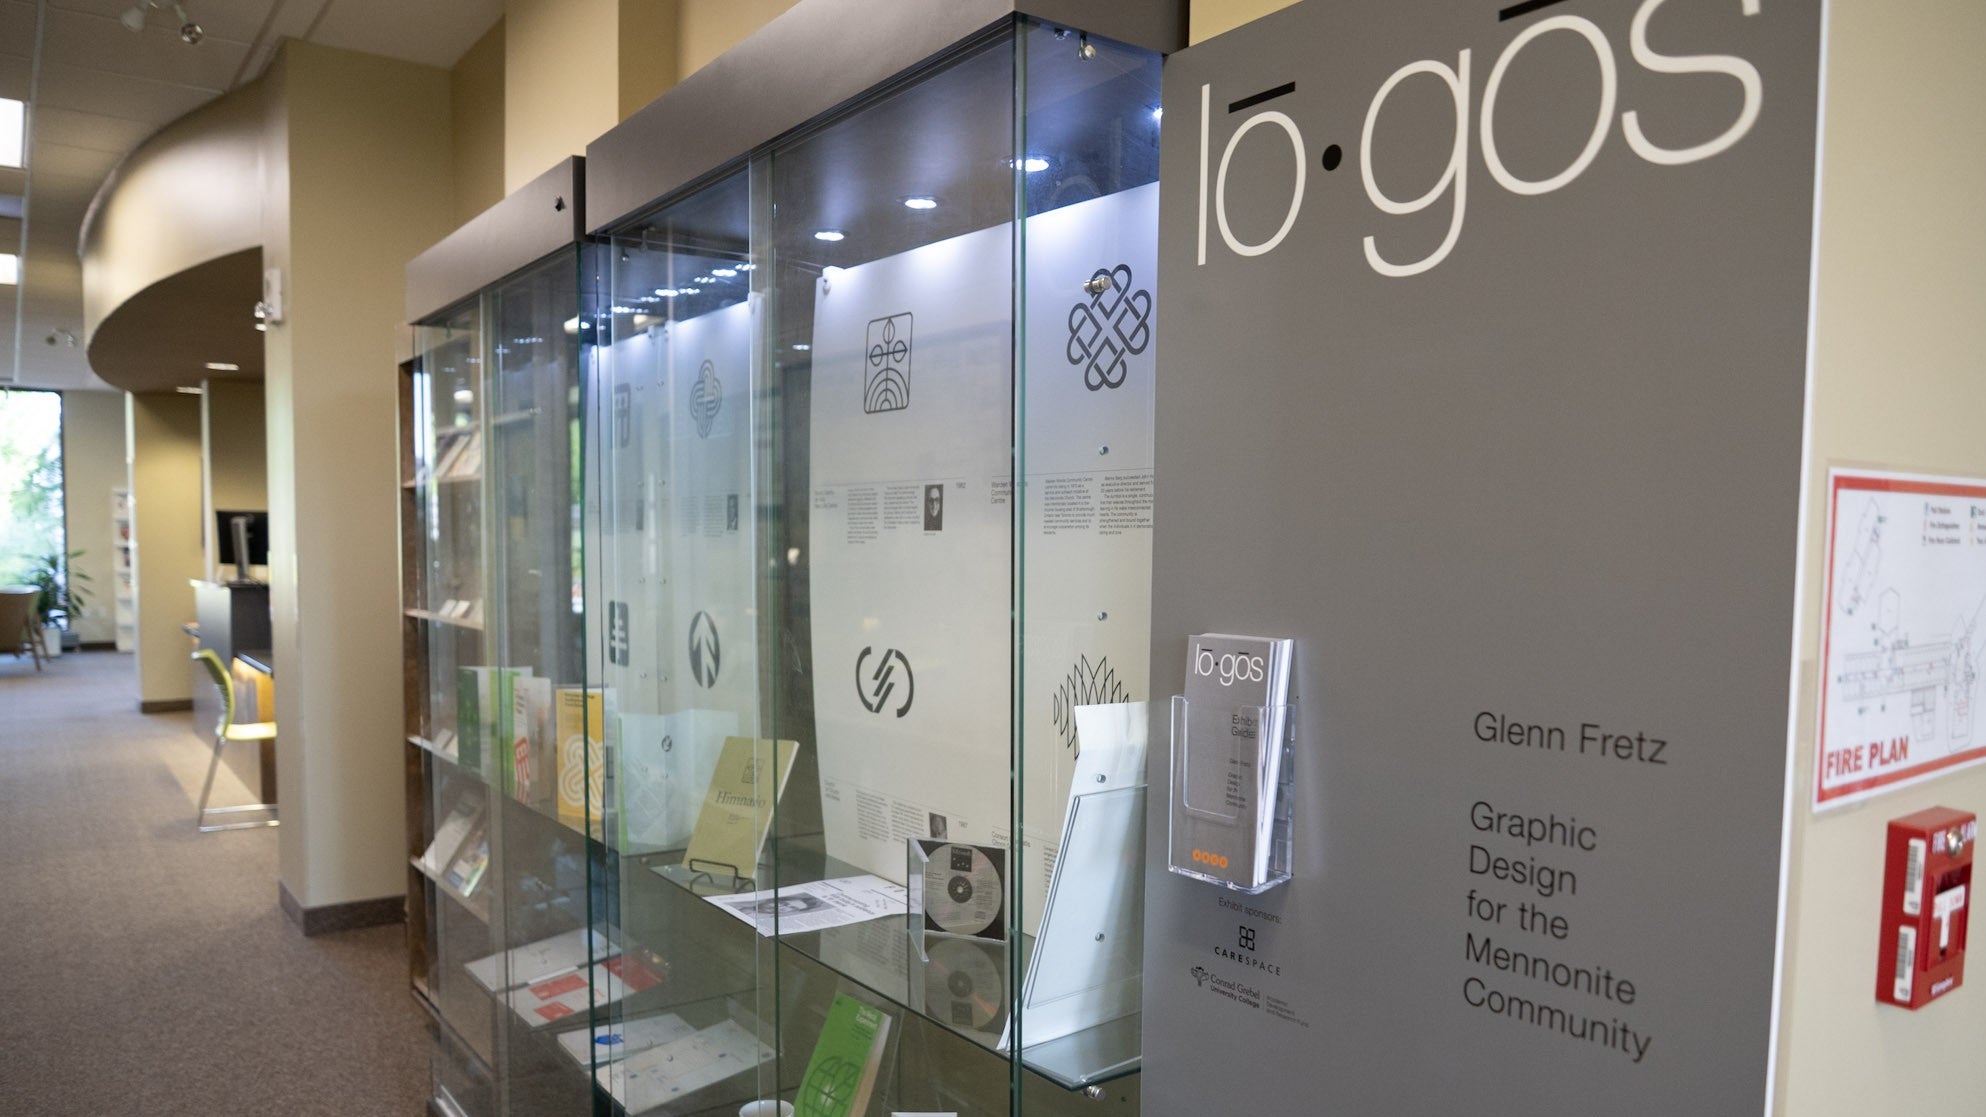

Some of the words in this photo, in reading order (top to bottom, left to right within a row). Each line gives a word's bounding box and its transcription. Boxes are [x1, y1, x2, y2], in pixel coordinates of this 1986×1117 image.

[1473, 711, 1565, 751] Glenn
[1579, 722, 1668, 765] Fretz
[1825, 747, 1863, 780] FIRE
[1869, 735, 1909, 767] PLAN
[1470, 800, 1598, 852] Graphic
[1469, 844, 1577, 898] Design
[1218, 897, 1243, 913] Exhibit
[1467, 889, 1507, 925] for
[1518, 901, 1569, 940] the
[1214, 946, 1281, 976] CARESPACE
[1465, 932, 1636, 1006] Mennonite
[1210, 974, 1236, 991] Conrad
[1237, 983, 1261, 1000] Grebel
[1210, 985, 1237, 1002] University
[1238, 994, 1260, 1009] College
[1463, 976, 1651, 1064] Community
